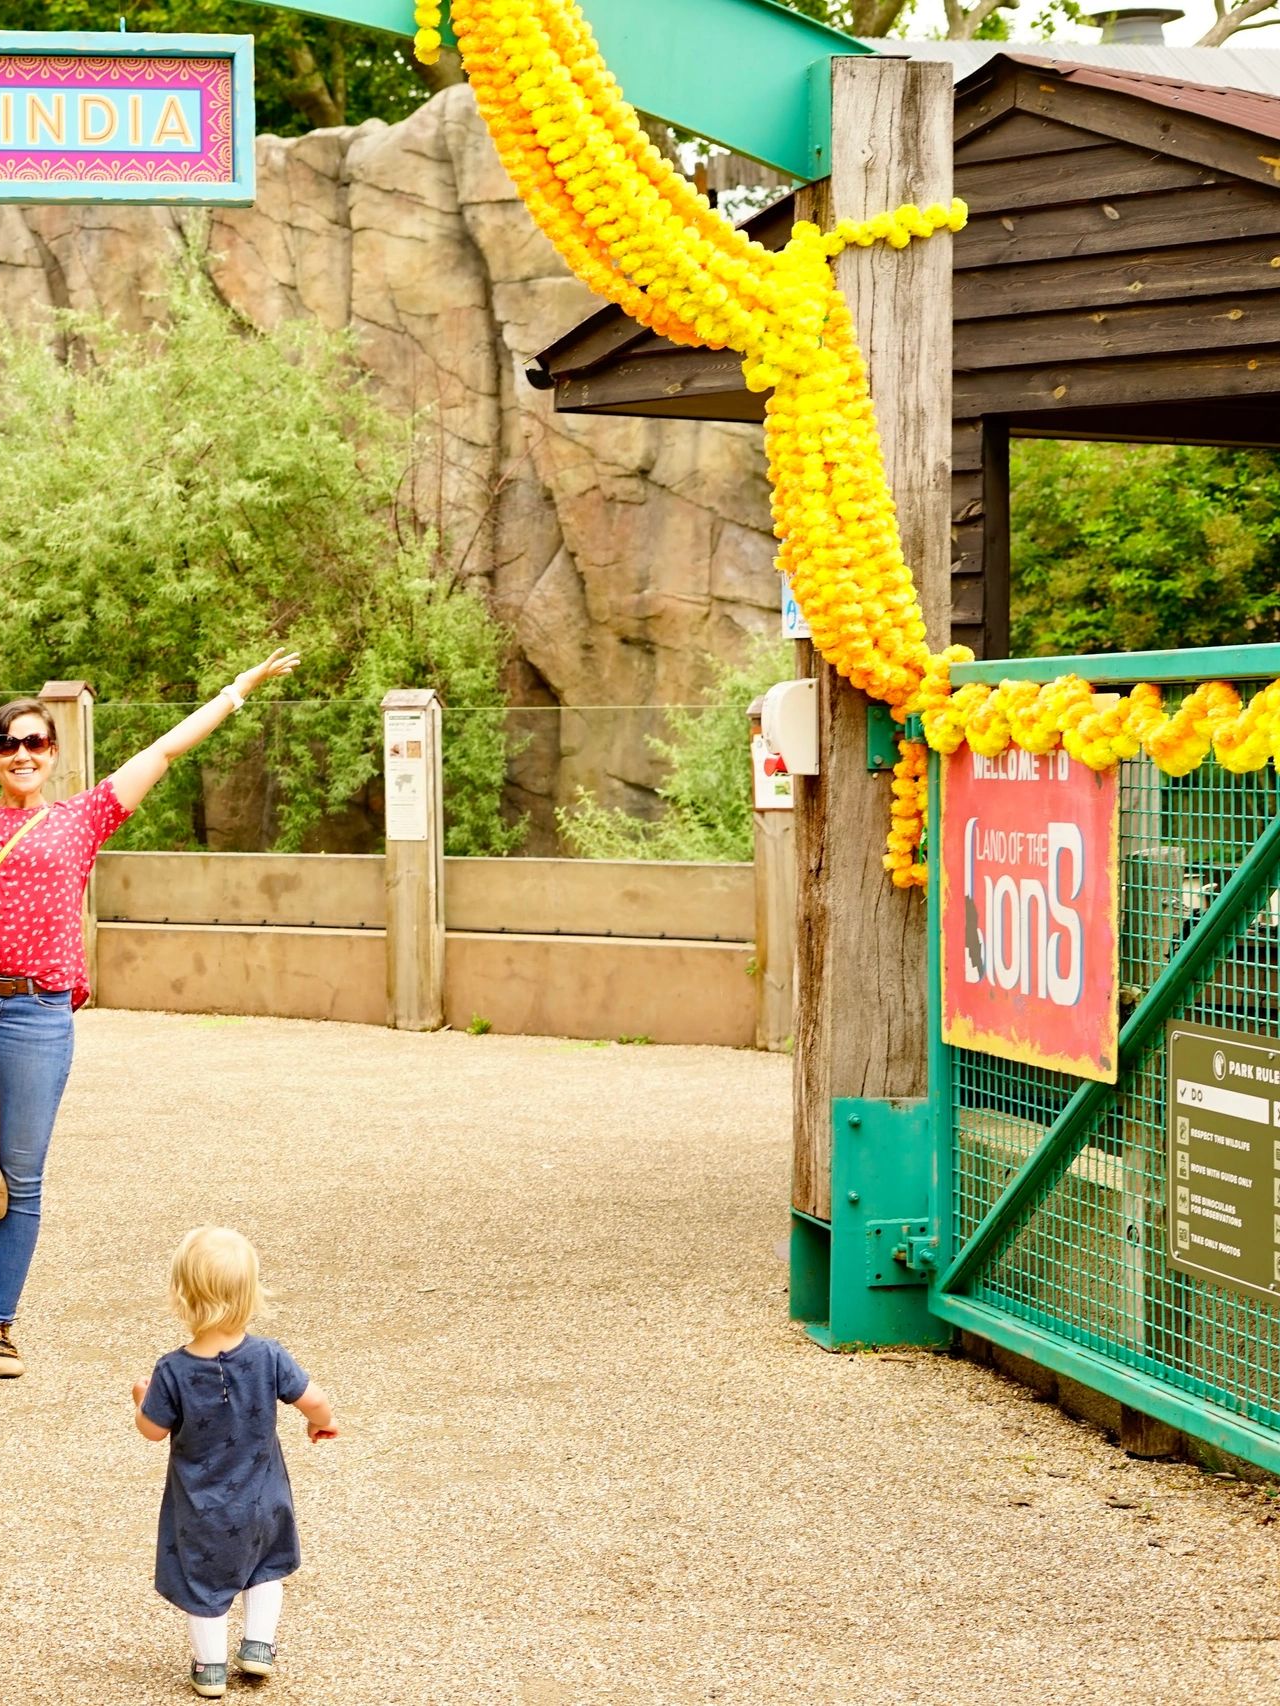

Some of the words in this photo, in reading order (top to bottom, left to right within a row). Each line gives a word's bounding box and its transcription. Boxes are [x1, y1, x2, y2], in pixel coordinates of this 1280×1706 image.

[973, 749, 1040, 781] WELCOME
[1048, 748, 1069, 781] TO
[975, 827, 1007, 865] LAND
[1007, 830, 1025, 865] OF
[1026, 832, 1049, 868] THE
[1228, 1060, 1254, 1079] PARK
[1191, 1088, 1203, 1102] DO
[1190, 1128, 1214, 1142] RESPECT
[1214, 1134, 1225, 1145] THE
[1225, 1137, 1251, 1152] WILDLIFE
[1190, 1162, 1206, 1175] MOVE
[1206, 1167, 1220, 1179] WITH
[1220, 1171, 1238, 1184] GUIDE
[1238, 1176, 1253, 1188] ONLY
[1190, 1193, 1202, 1205] USE
[1202, 1197, 1236, 1215] BINOCULARS
[1190, 1204, 1202, 1215] FOR
[1190, 1233, 1204, 1245] TAKE
[1204, 1238, 1219, 1251] ONLY
[1218, 1242, 1242, 1258] PHOTOS
